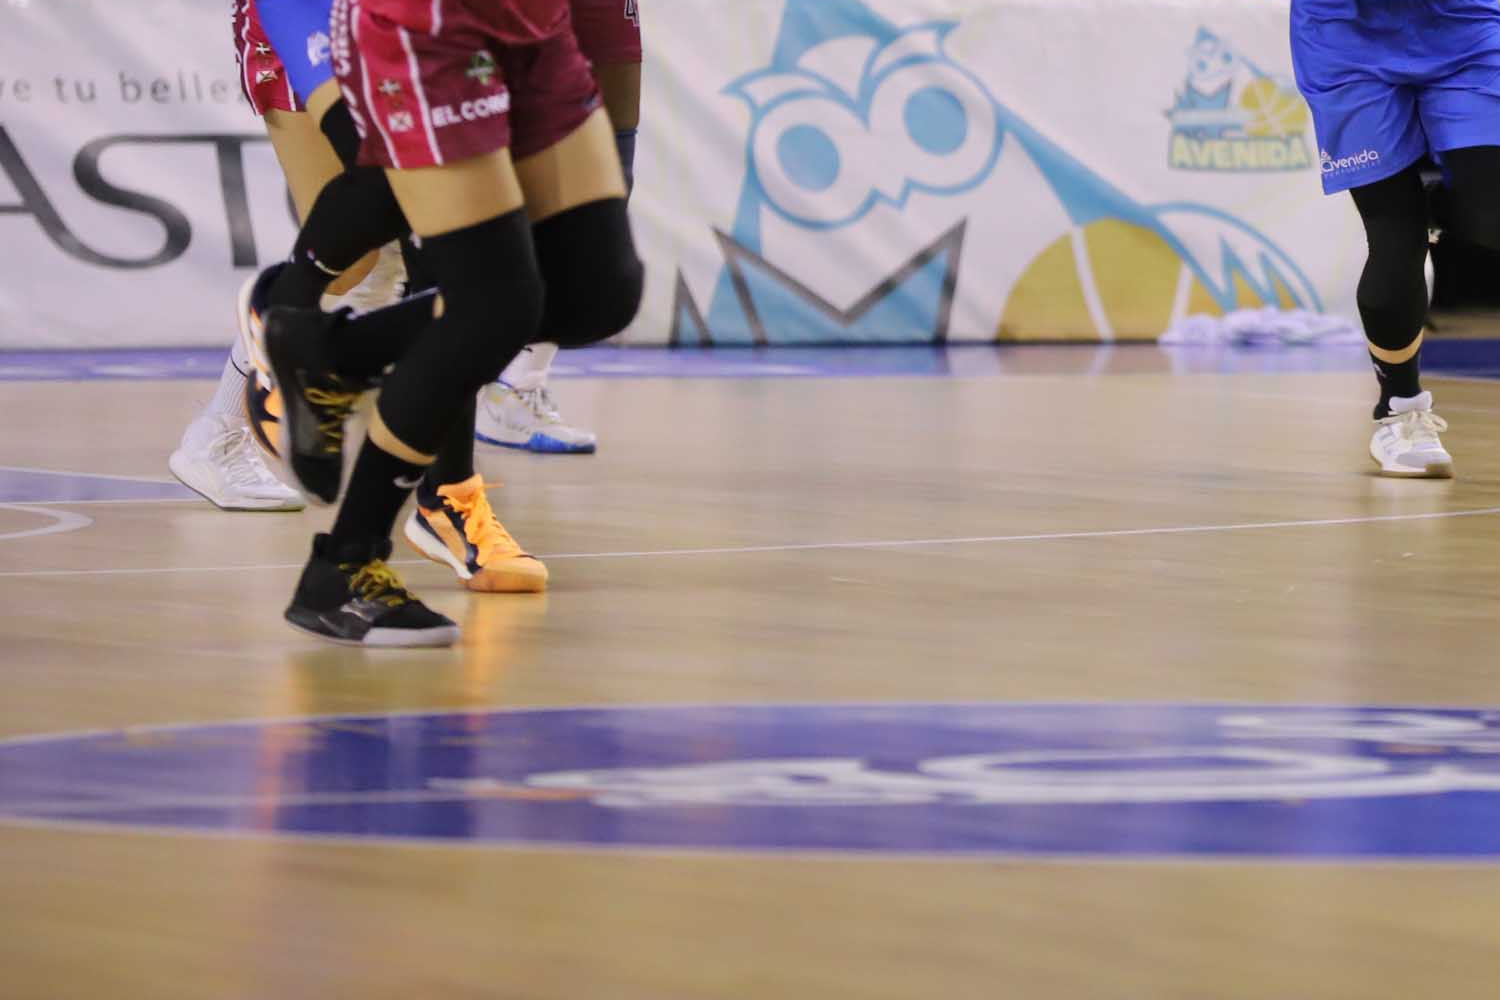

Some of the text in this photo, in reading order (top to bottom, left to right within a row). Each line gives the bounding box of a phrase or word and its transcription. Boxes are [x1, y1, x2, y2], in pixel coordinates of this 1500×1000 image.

[54, 74, 97, 104] tu
[431, 104, 462, 129] EL
[1169, 134, 1312, 169] AVENIDA
[1320, 149, 1380, 173] avenida
